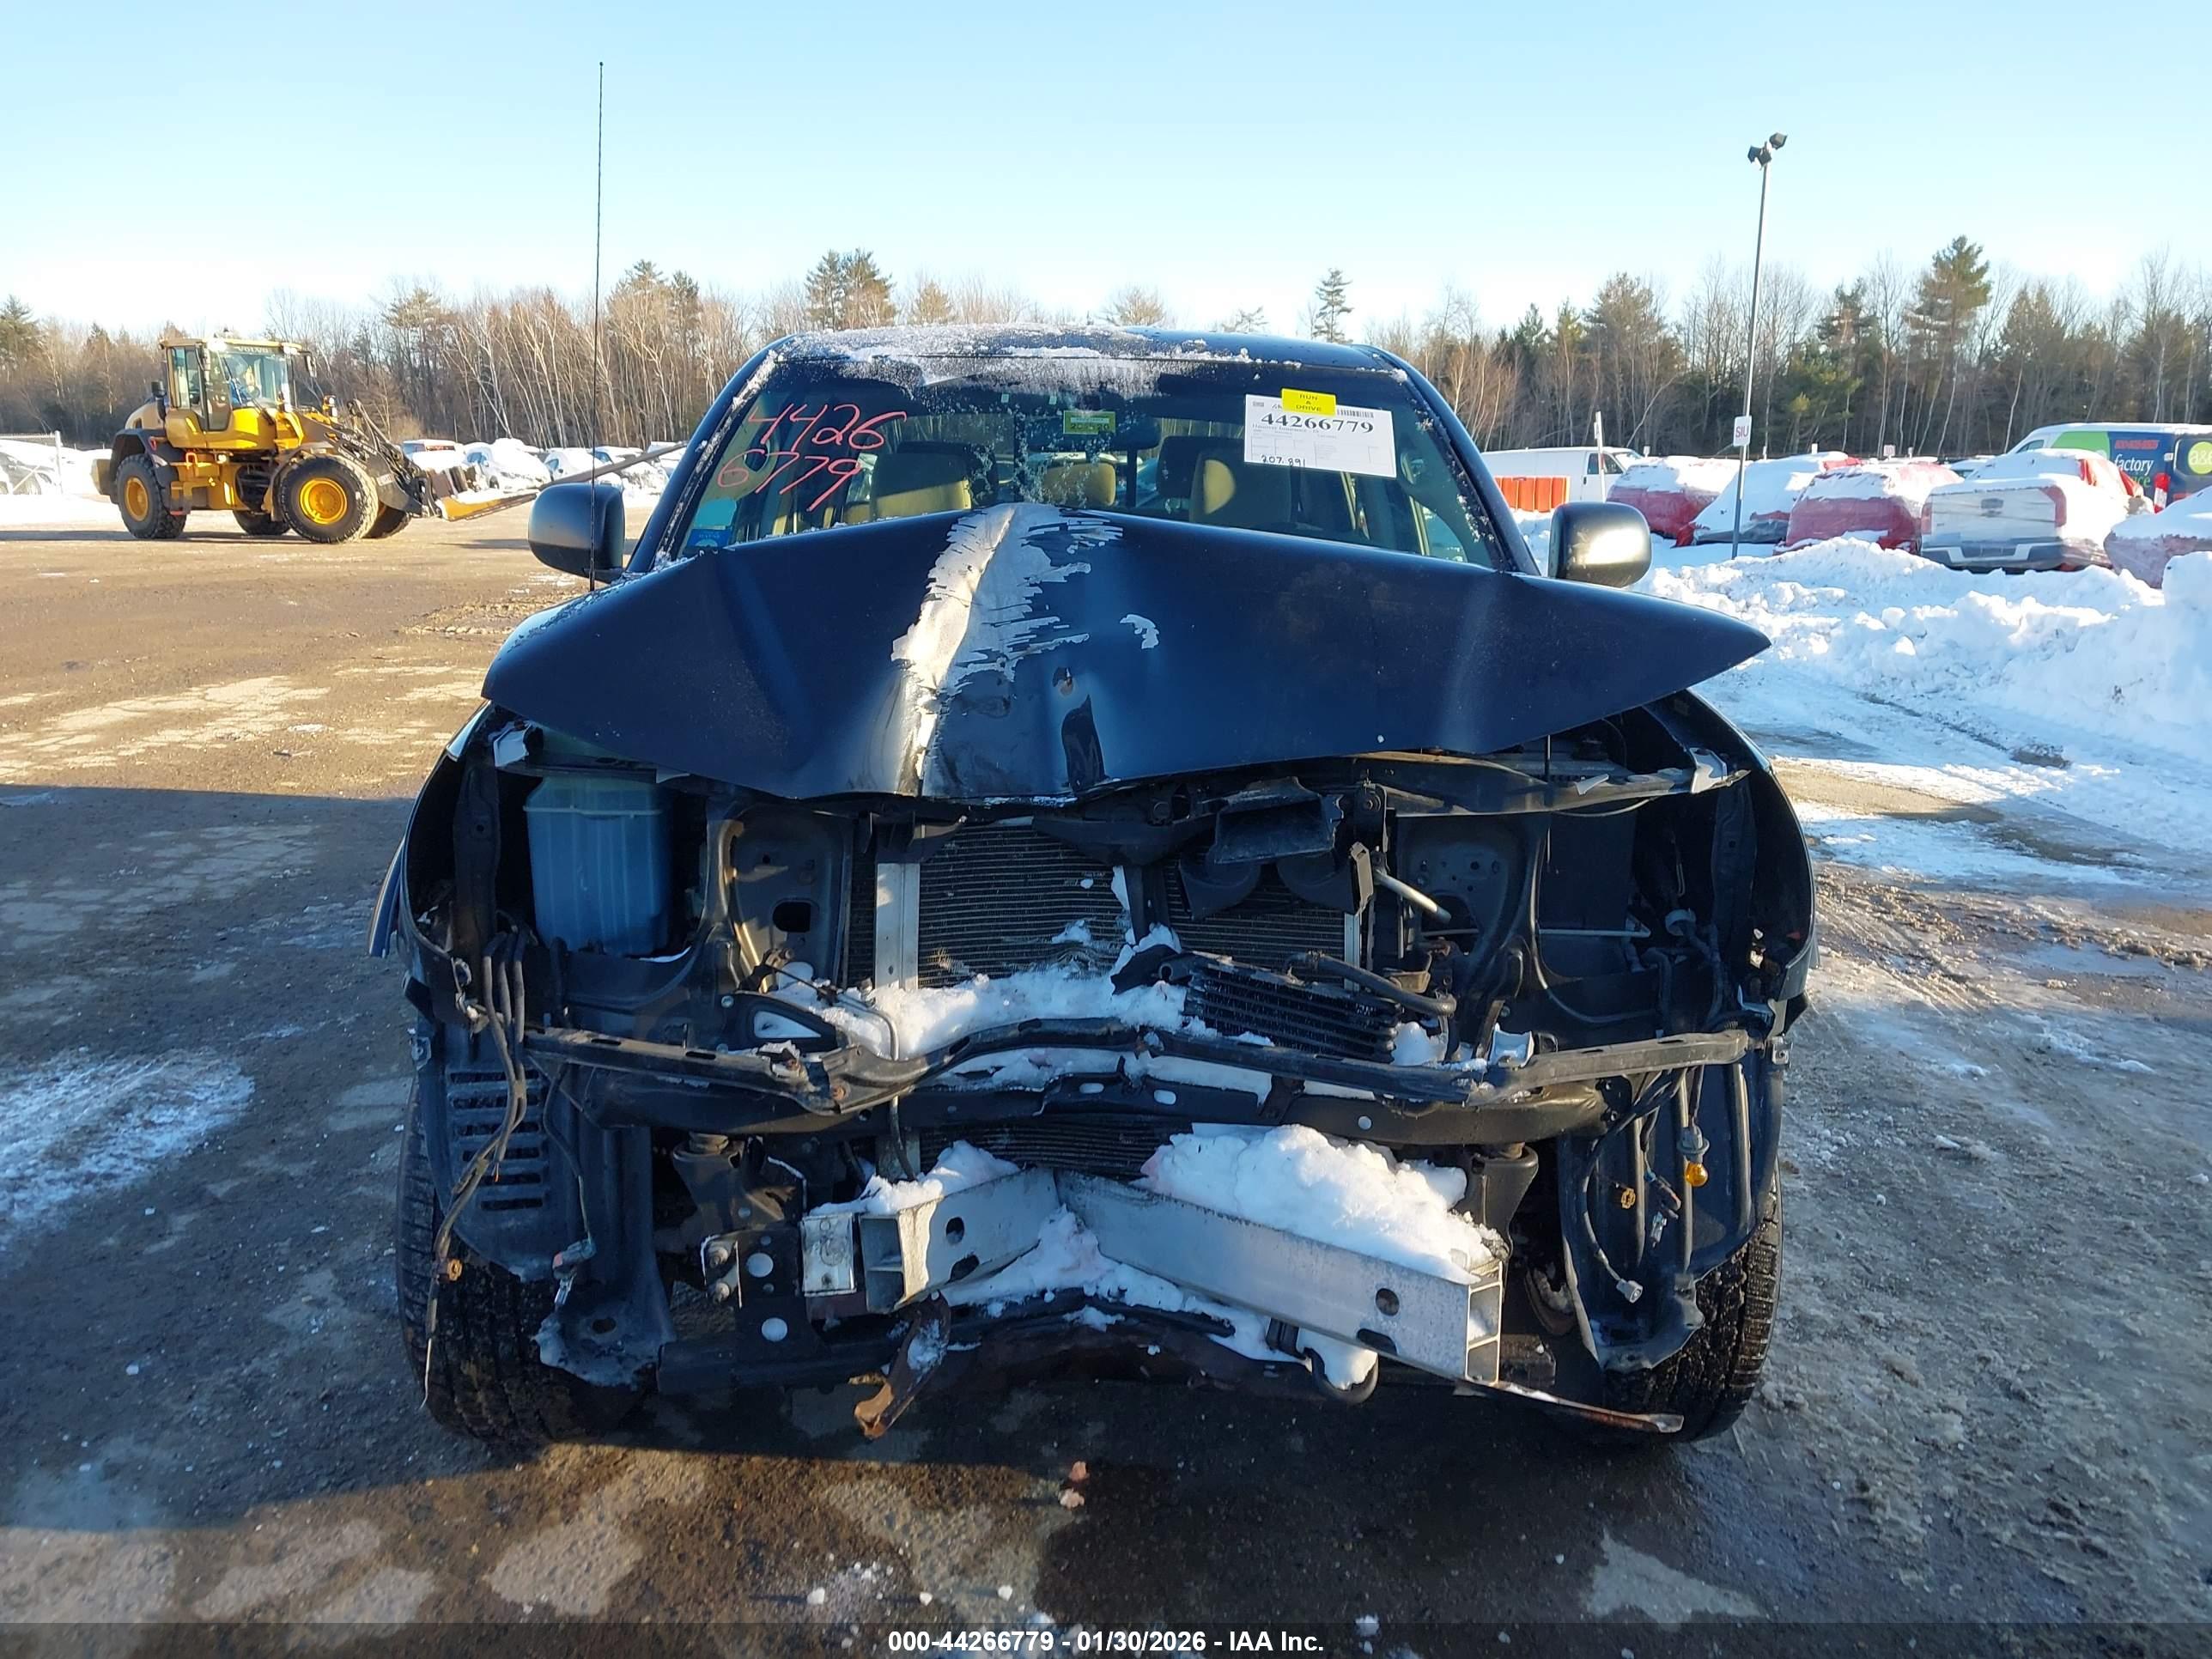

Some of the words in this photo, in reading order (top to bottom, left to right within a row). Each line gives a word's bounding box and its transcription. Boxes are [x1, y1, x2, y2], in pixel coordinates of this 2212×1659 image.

[1295, 404, 1322, 412] DRIVE
[748, 403, 908, 453] 4426
[1261, 412, 1375, 434] 44266779
[1735, 425, 1749, 438] SIU
[2114, 453, 2154, 477] factory
[717, 449, 864, 512] 6779
